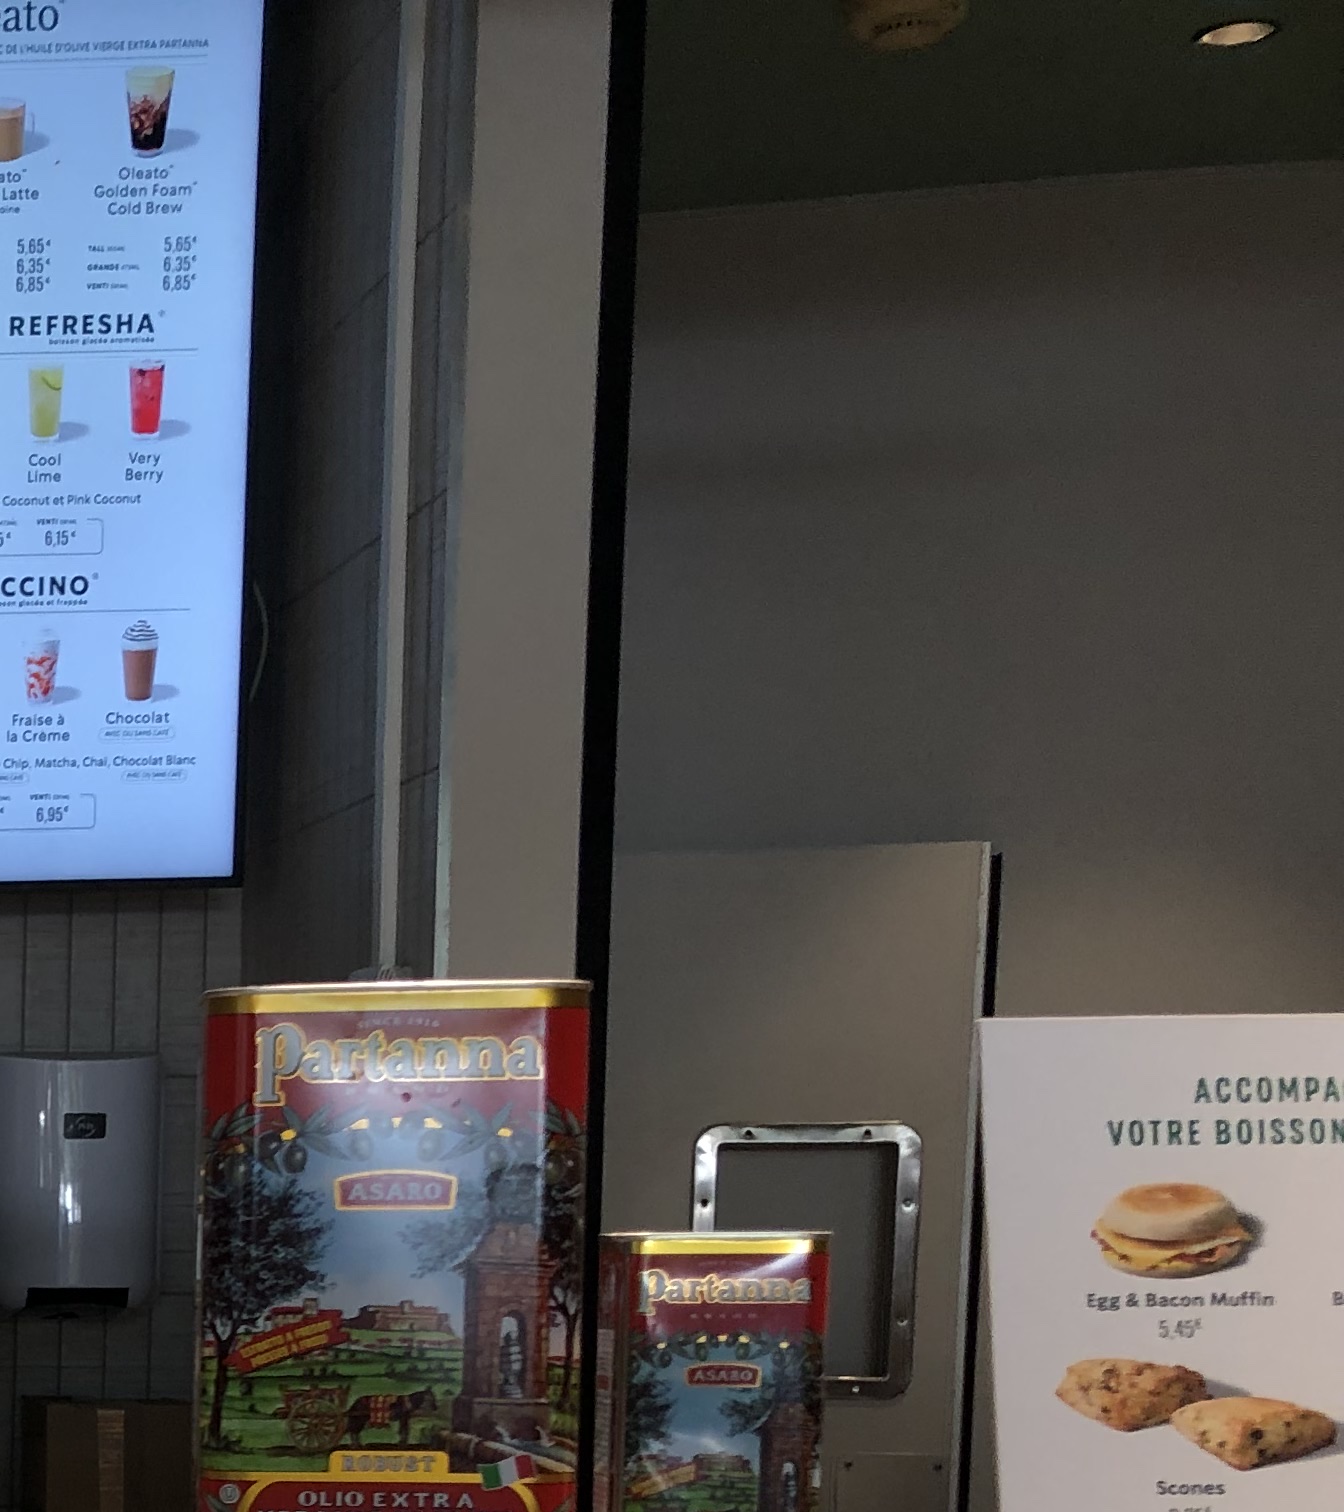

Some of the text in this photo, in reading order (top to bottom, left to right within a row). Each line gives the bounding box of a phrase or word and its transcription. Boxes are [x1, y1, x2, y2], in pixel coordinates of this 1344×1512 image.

[2, 187, 39, 200] Latte
[94, 184, 147, 199] Golden
[108, 202, 182, 215] Cold Brew
[9, 313, 154, 337] REFRESHA
[29, 454, 61, 467] Cool
[128, 452, 161, 468] Very
[27, 470, 61, 483] Lime
[125, 468, 163, 484] Berry
[12, 714, 53, 727] Fraise
[106, 711, 170, 726] Chocolat
[7, 730, 17, 742] la
[253, 1022, 544, 1107] Partanna
[1108, 1119, 1201, 1146] VOTRE
[348, 1179, 443, 1202] ASARO
[636, 1269, 812, 1316] Partanna
[1087, 1292, 1274, 1310] Egg & Bacon Muffin
[341, 1454, 438, 1472] ROBUST
[1156, 1480, 1226, 1495] Scones
[297, 1491, 473, 1509] OLIO EXTRA
